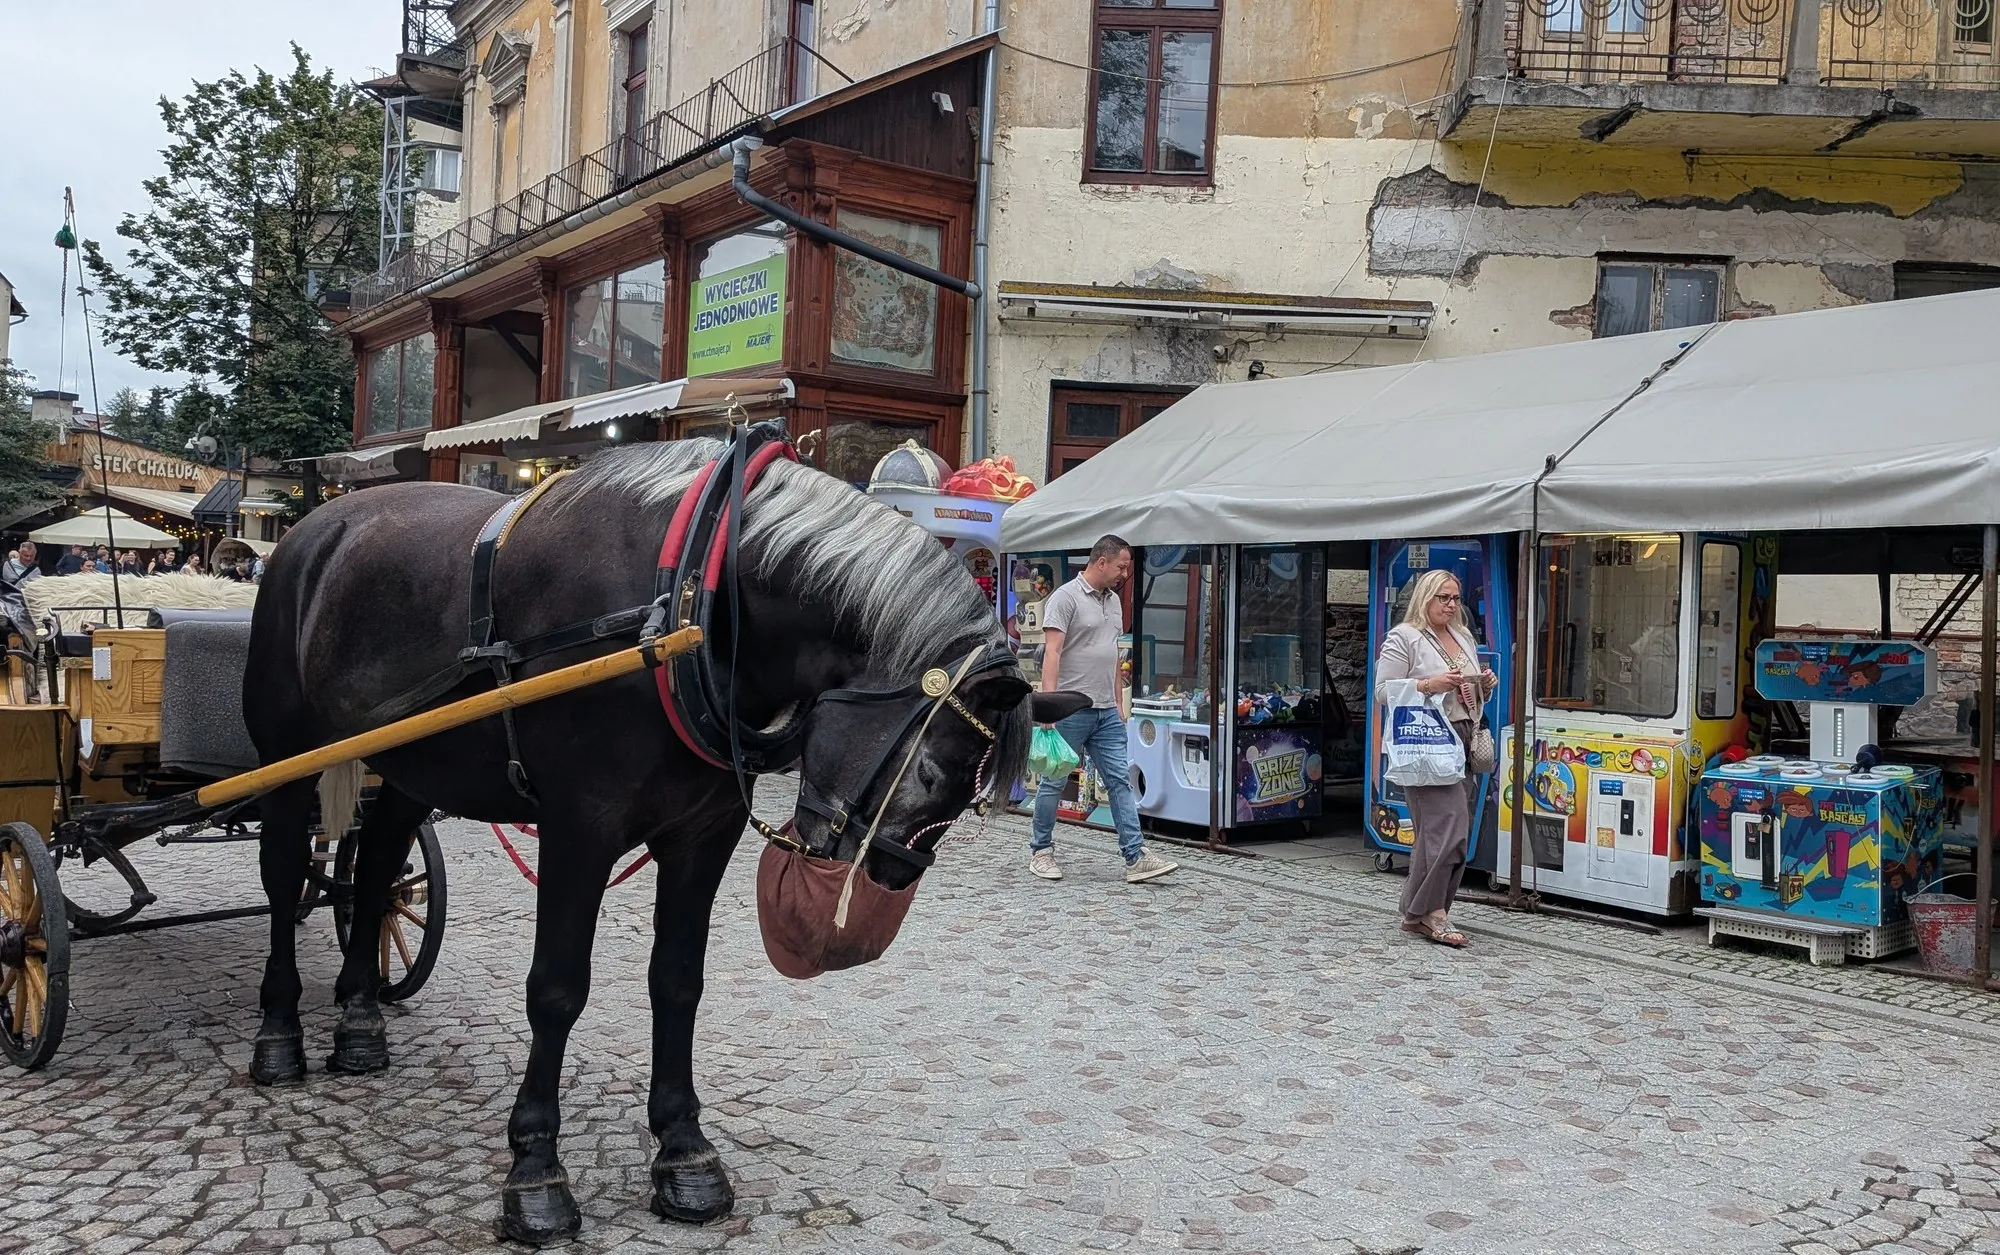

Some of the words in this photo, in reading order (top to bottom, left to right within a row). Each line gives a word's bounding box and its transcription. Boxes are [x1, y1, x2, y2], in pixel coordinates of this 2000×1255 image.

[705, 270, 768, 305] WYCIECZKI
[693, 293, 778, 331] JEDNODNIOWE
[692, 341, 732, 360] www.ctmajer.pl
[746, 335, 771, 349] MAJER
[92, 454, 131, 474] STEK
[1255, 752, 1304, 779] PRIZE
[1259, 771, 1303, 798] ZONE
[1819, 809, 1866, 826] RASCALS
